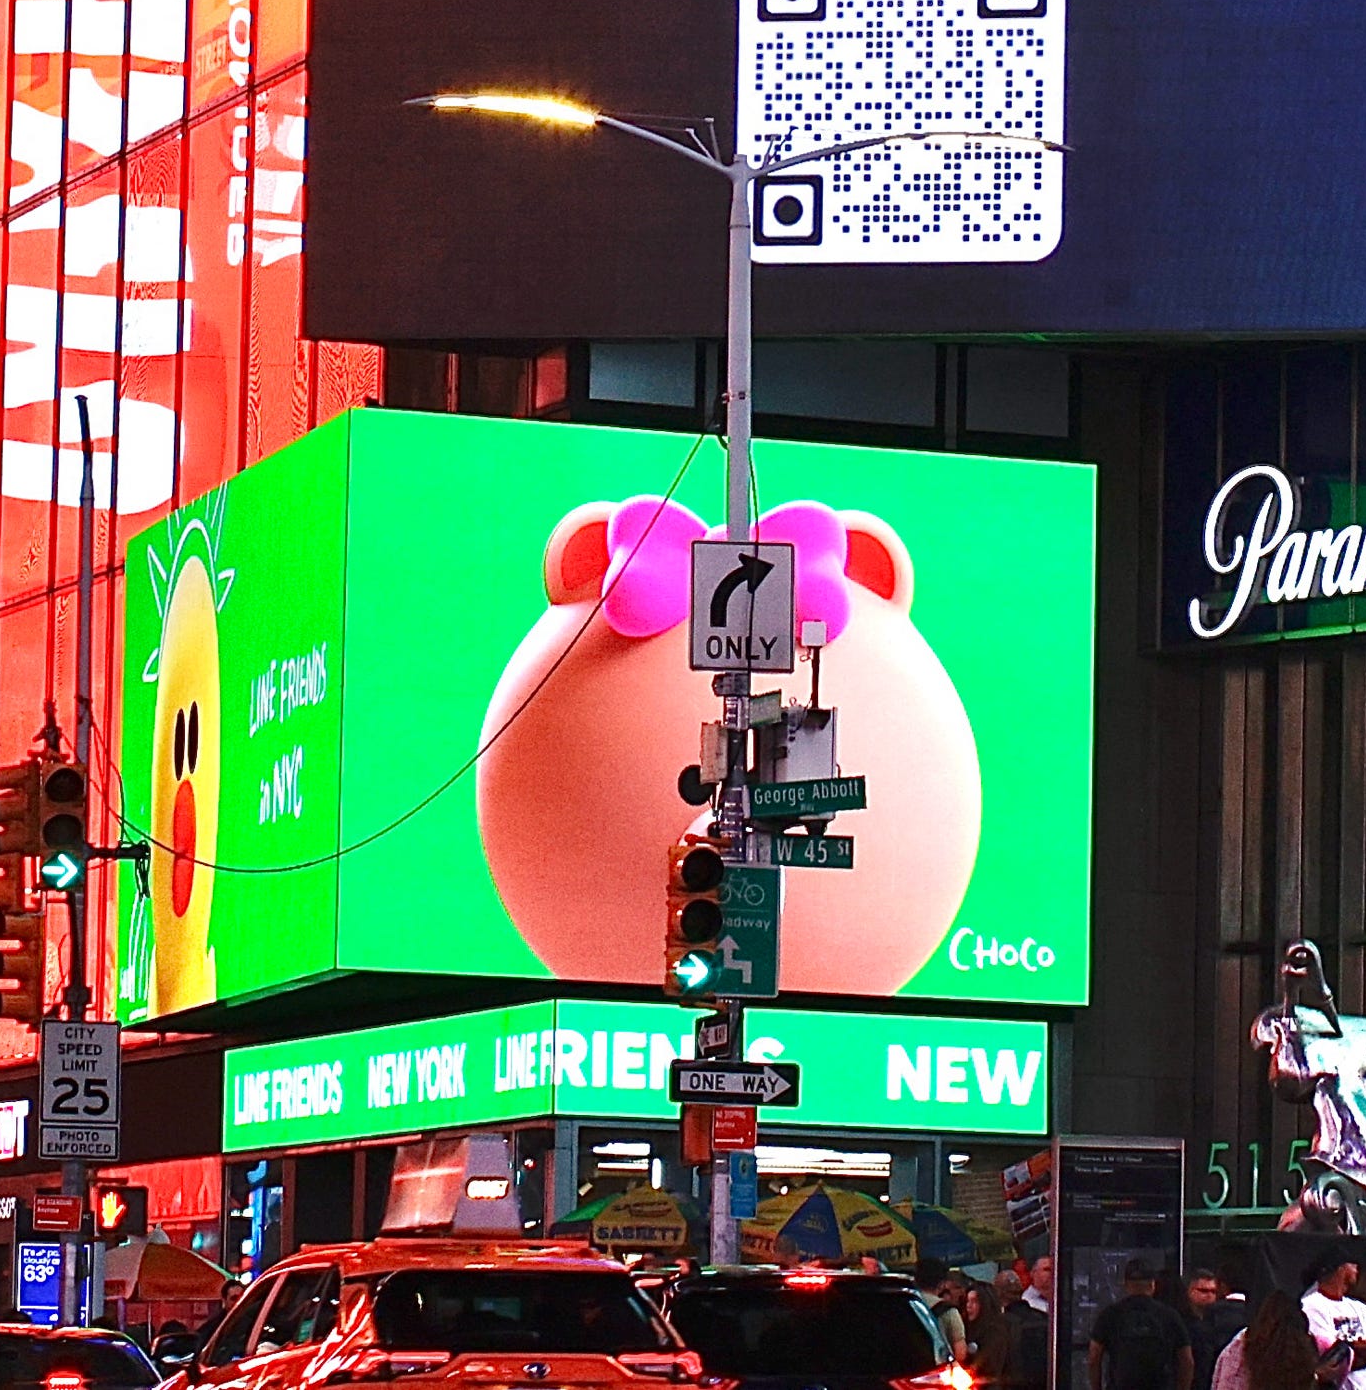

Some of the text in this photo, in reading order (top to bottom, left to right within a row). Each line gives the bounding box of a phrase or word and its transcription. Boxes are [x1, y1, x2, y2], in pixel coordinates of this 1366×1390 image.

[706, 635, 778, 660] ONLY
[249, 642, 328, 738] LINE FRIENDS
[272, 744, 304, 824] NYC
[754, 778, 860, 807] George Abbott
[777, 839, 850, 864] W 45 St
[64, 1027, 96, 1040] CITY
[57, 1043, 103, 1056] SPEED
[61, 1059, 98, 1072] LIMIT
[234, 1072, 268, 1126] LINE
[271, 1060, 343, 1121] FRIENDS
[367, 1048, 413, 1110] NEW
[415, 1042, 467, 1103] YORK
[494, 1031, 537, 1094] LINE
[886, 1044, 1042, 1105] NEW
[689, 1072, 780, 1094] ONE WAY
[51, 1076, 110, 1117] 25
[47, 1142, 112, 1154] ENFORCED
[59, 1130, 100, 1142] PHOTO
[1202, 1141, 1310, 1211] 515
